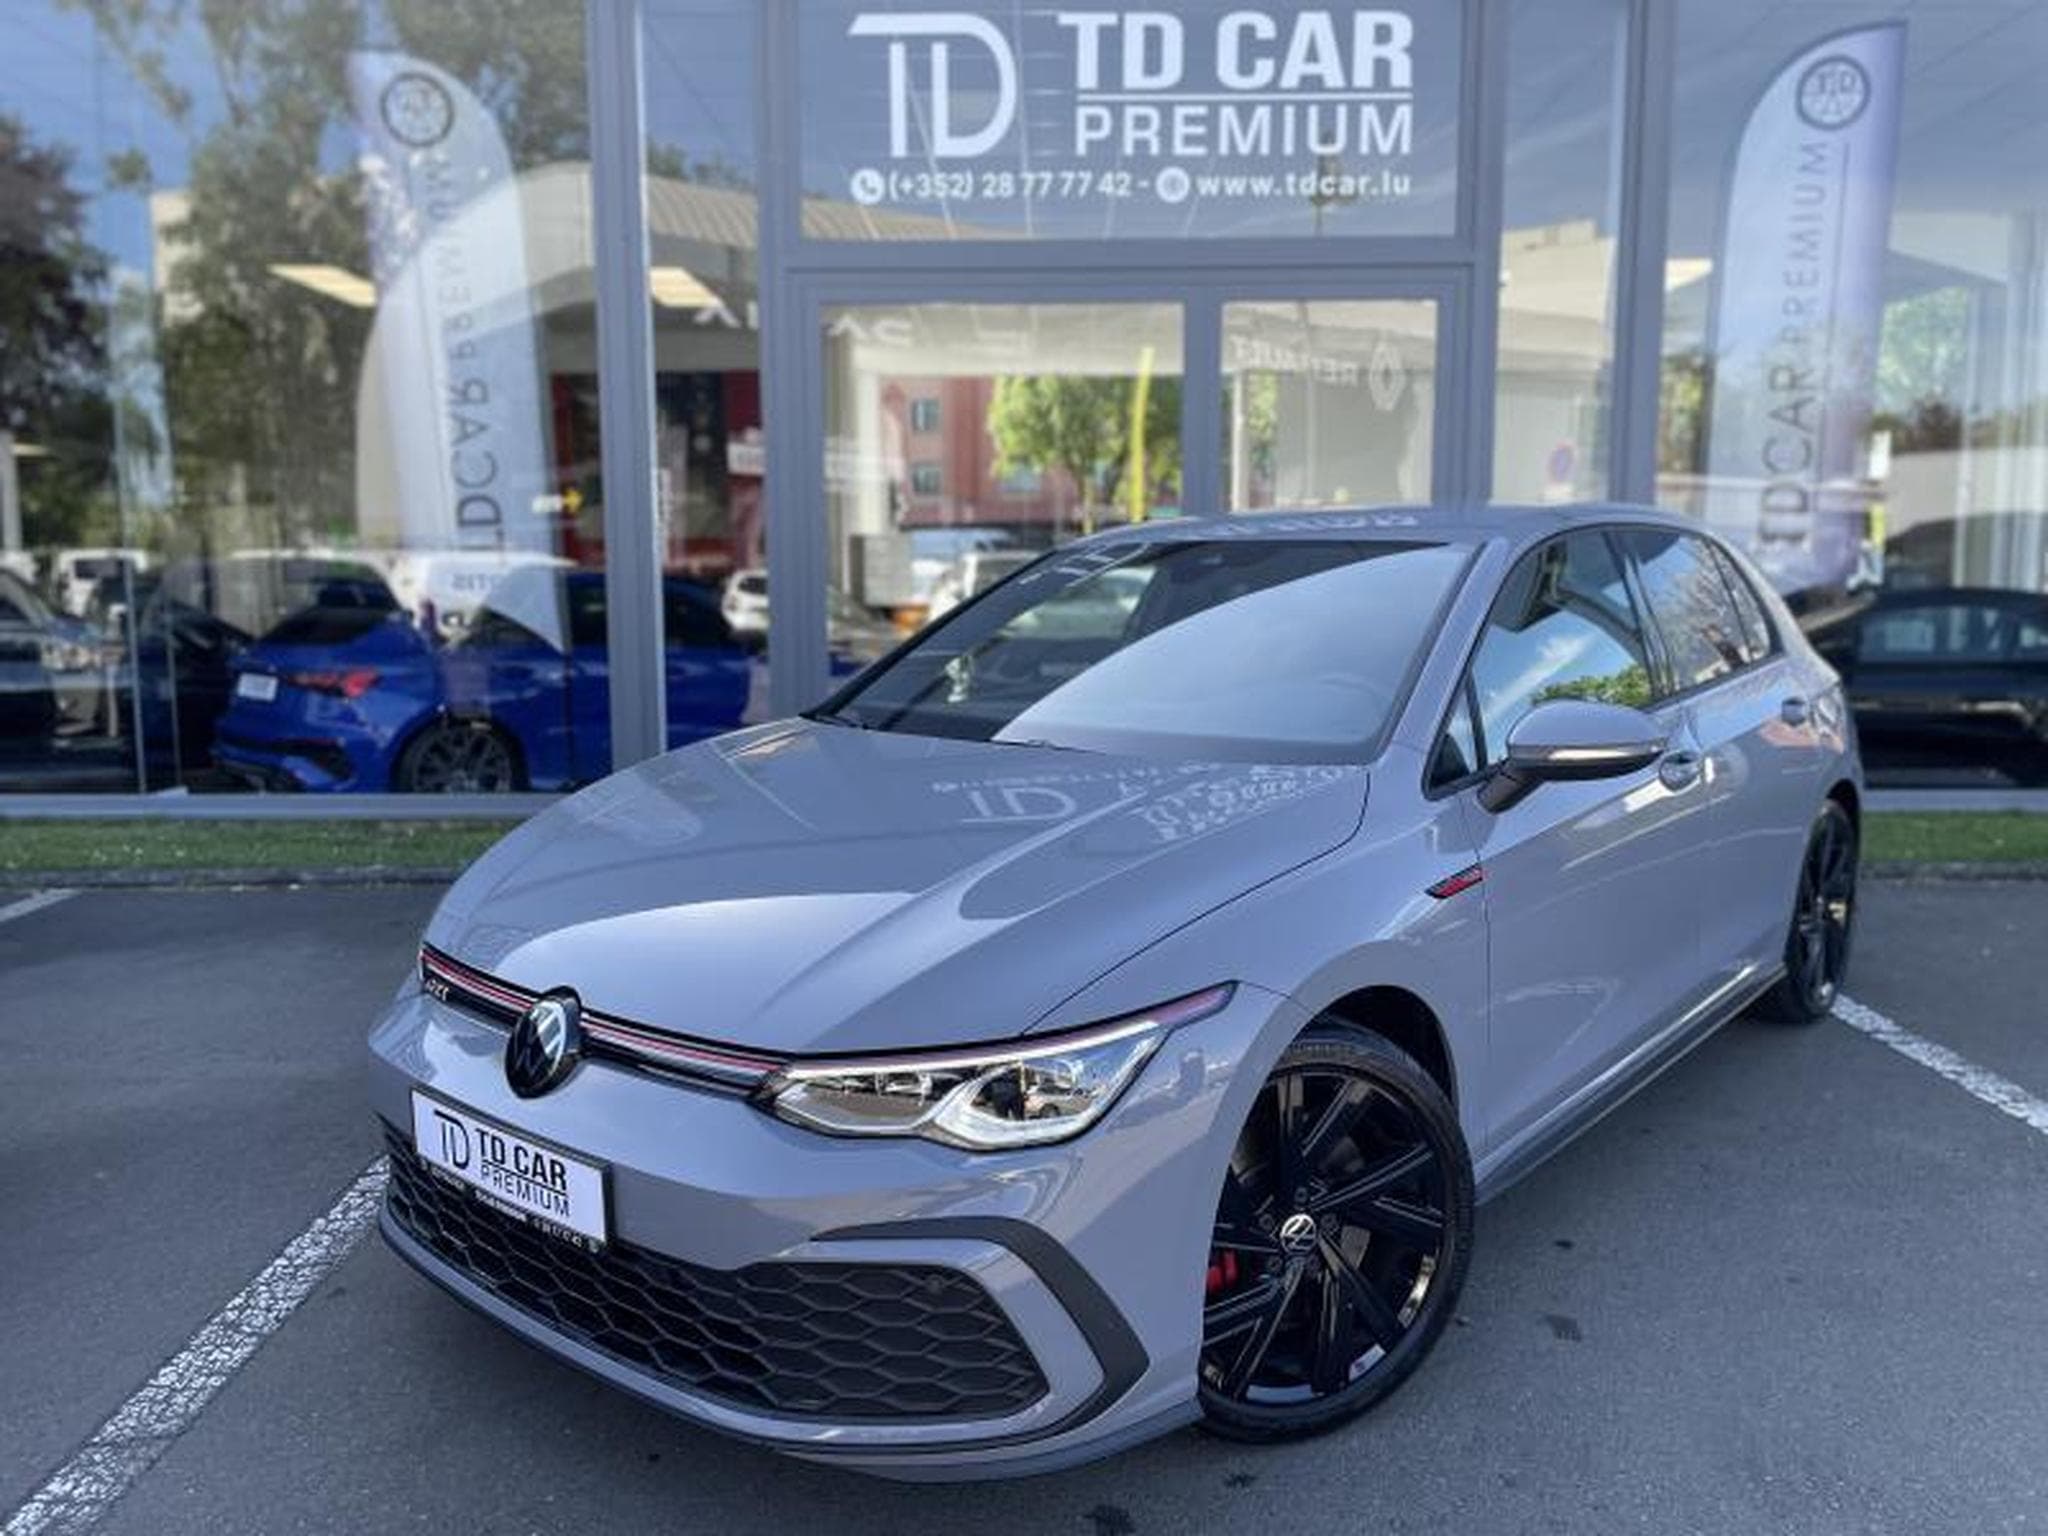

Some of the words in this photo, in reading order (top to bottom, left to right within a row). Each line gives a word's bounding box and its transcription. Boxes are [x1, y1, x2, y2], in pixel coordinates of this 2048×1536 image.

[1058, 12, 1183, 89] TD
[1216, 11, 1414, 89] CAR
[1075, 103, 1413, 157] PREMIUM
[889, 169, 974, 200] (+352)
[982, 171, 1014, 198] 28
[1021, 171, 1052, 198] 77
[1060, 171, 1093, 198] 77
[1097, 171, 1132, 198] 42
[1196, 170, 1412, 196] www.tdcar.lu
[475, 1127, 506, 1165] TD
[513, 1145, 568, 1192] CAR
[480, 1164, 571, 1218] PREMIUM
